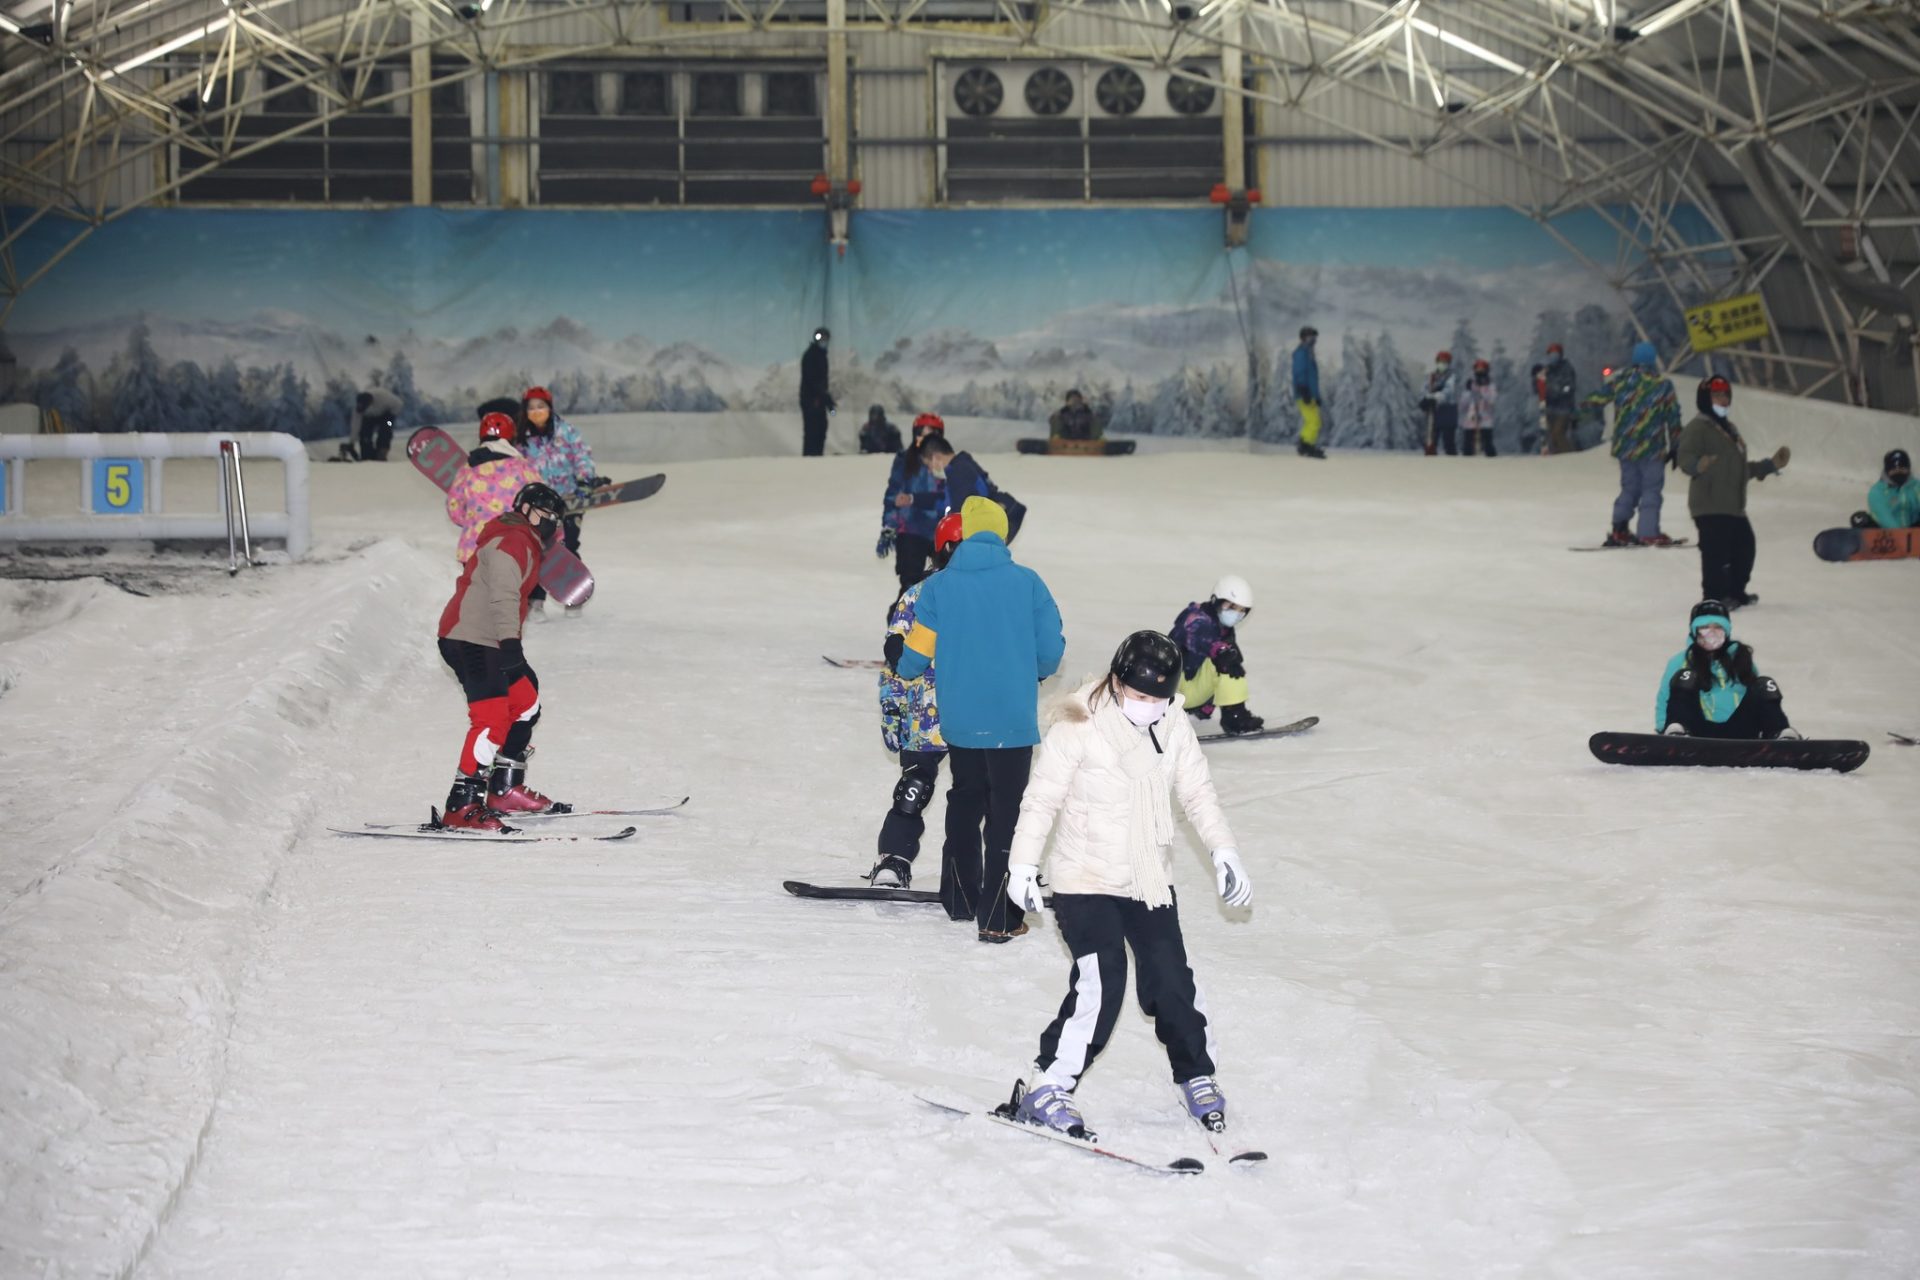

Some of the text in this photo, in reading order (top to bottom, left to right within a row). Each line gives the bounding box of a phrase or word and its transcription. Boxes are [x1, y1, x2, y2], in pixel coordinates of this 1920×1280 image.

[106, 464, 130, 507] 5
[1680, 670, 1691, 681] S
[1766, 679, 1777, 692] S
[904, 786, 919, 801] S
